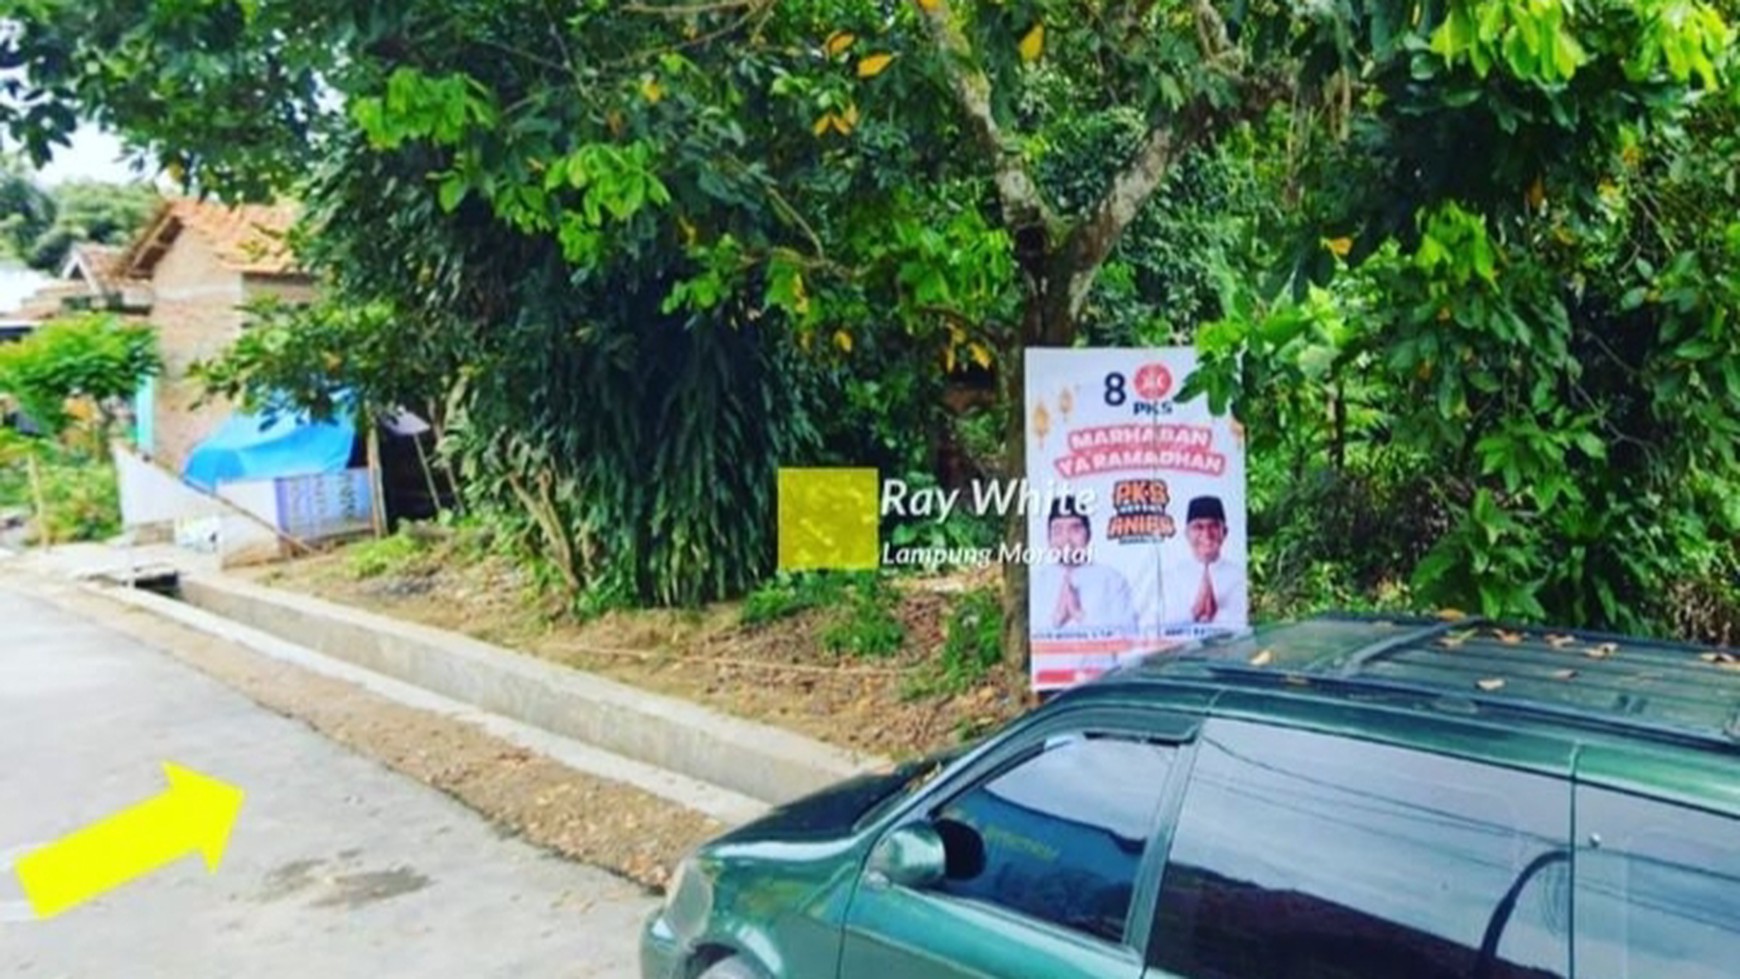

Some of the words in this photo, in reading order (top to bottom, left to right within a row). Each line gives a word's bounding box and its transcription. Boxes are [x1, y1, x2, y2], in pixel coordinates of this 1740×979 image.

[1104, 372, 1126, 406] 8
[1134, 401, 1172, 415] PKS
[1070, 427, 1210, 448] MARHABAN
[1058, 456, 1091, 477] YA
[1093, 450, 1223, 474] RAMADHAN
